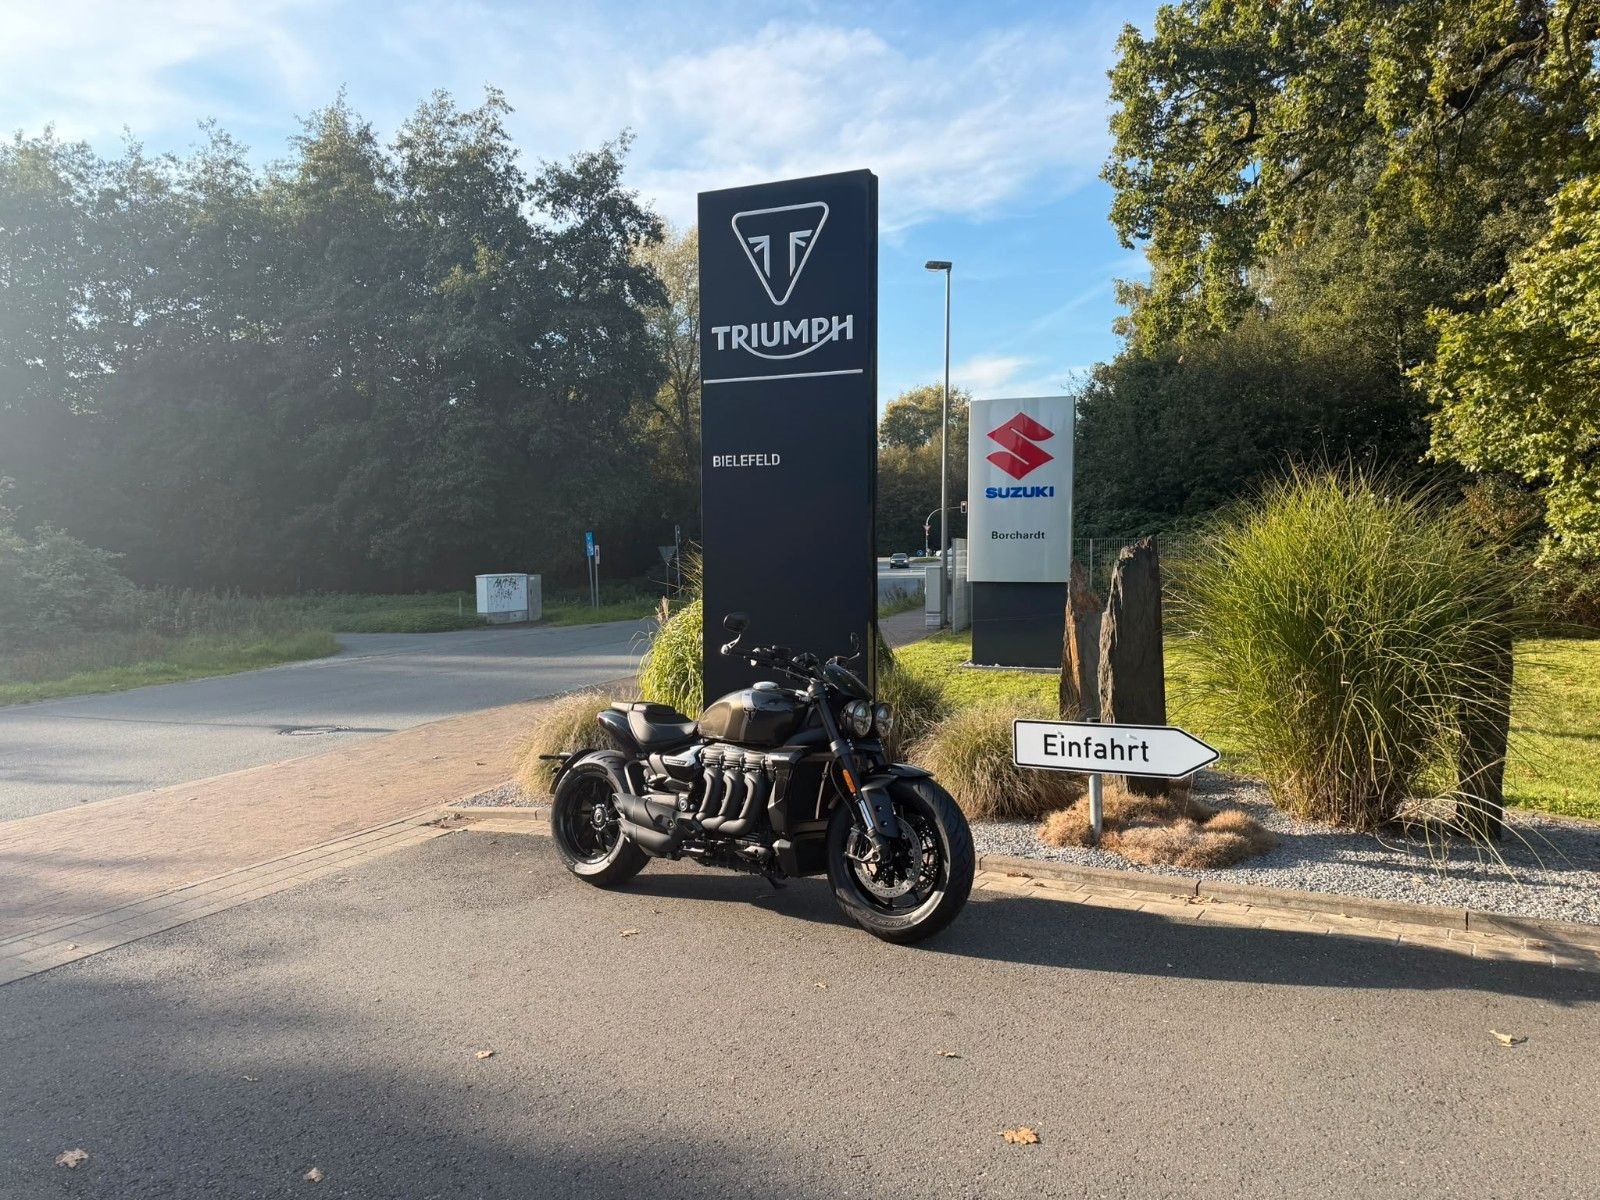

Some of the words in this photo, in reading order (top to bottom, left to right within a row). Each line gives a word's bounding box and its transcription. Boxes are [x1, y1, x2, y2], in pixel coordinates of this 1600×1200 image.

[712, 315, 853, 359] TRIUMPH
[712, 454, 781, 468] BIELEFELD
[985, 486, 1054, 498] SUZUKI
[991, 531, 1045, 540] Borchardt
[1043, 733, 1149, 762] Einfahrt
